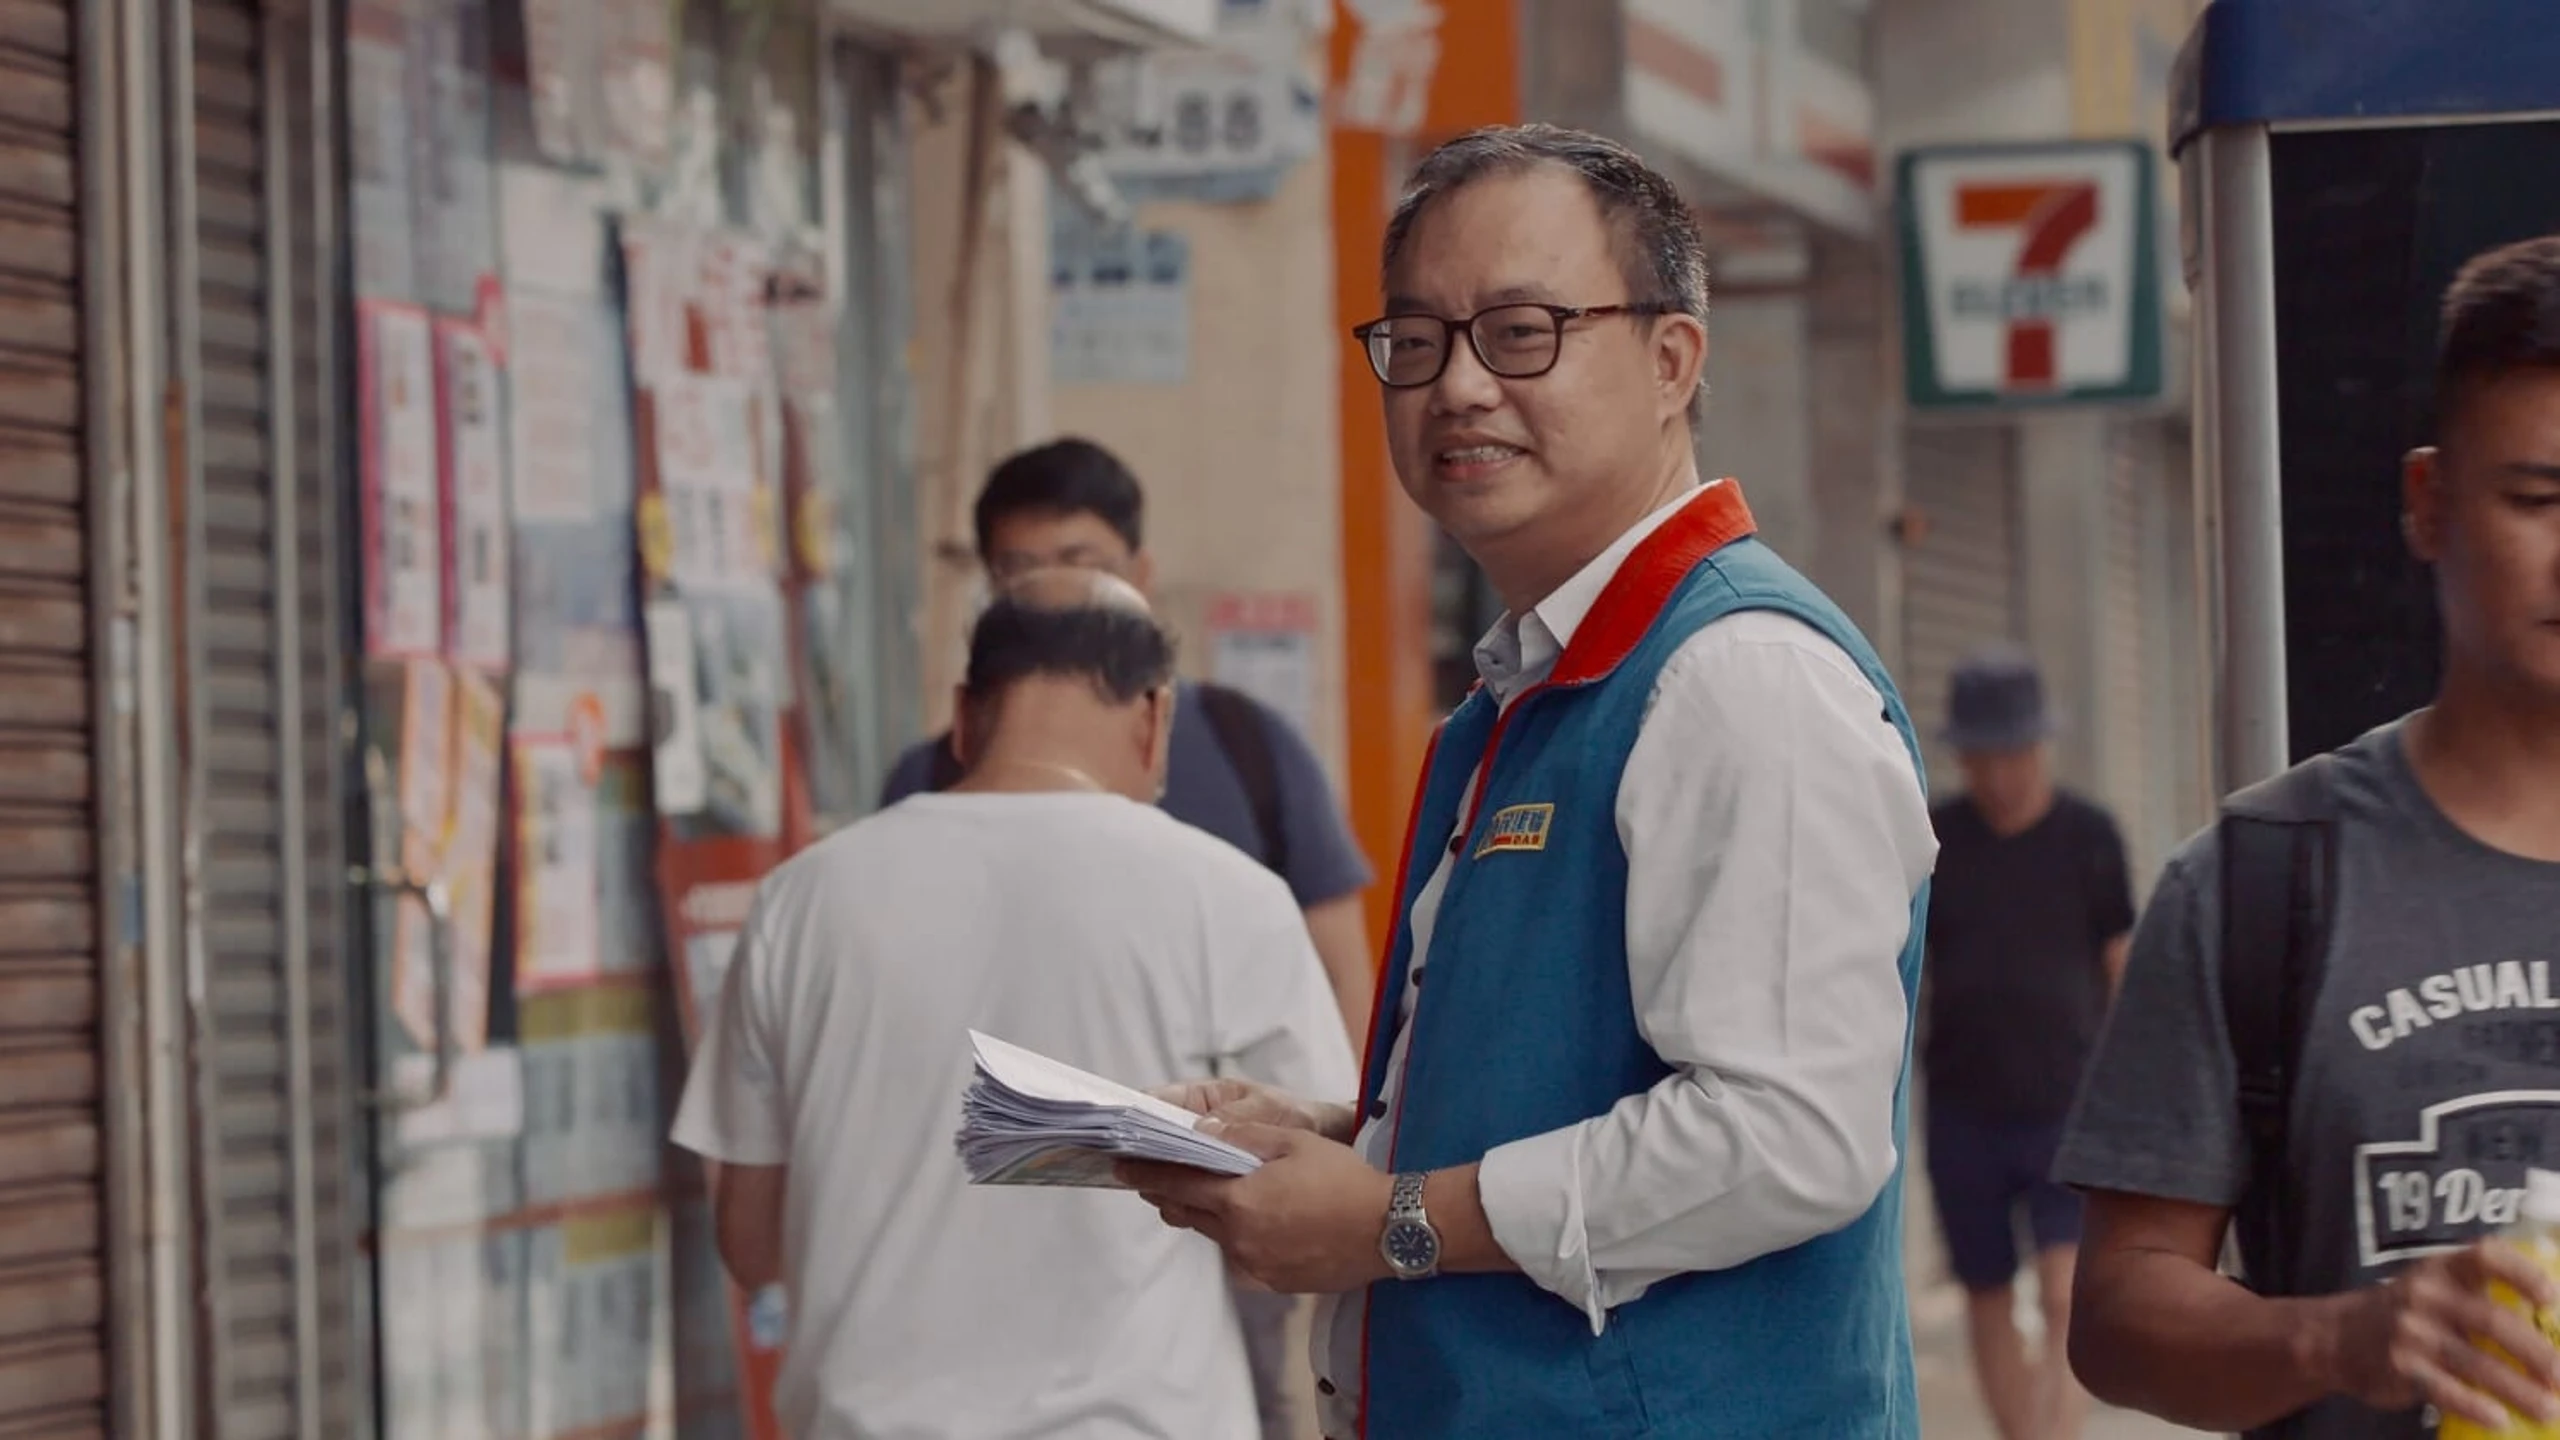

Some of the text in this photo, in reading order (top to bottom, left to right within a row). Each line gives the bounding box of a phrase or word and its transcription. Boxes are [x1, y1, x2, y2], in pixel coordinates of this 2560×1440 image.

[1954, 178, 2101, 389] 7
[2349, 960, 2560, 1051] CASUAL
[2377, 1170, 2431, 1231] 19
